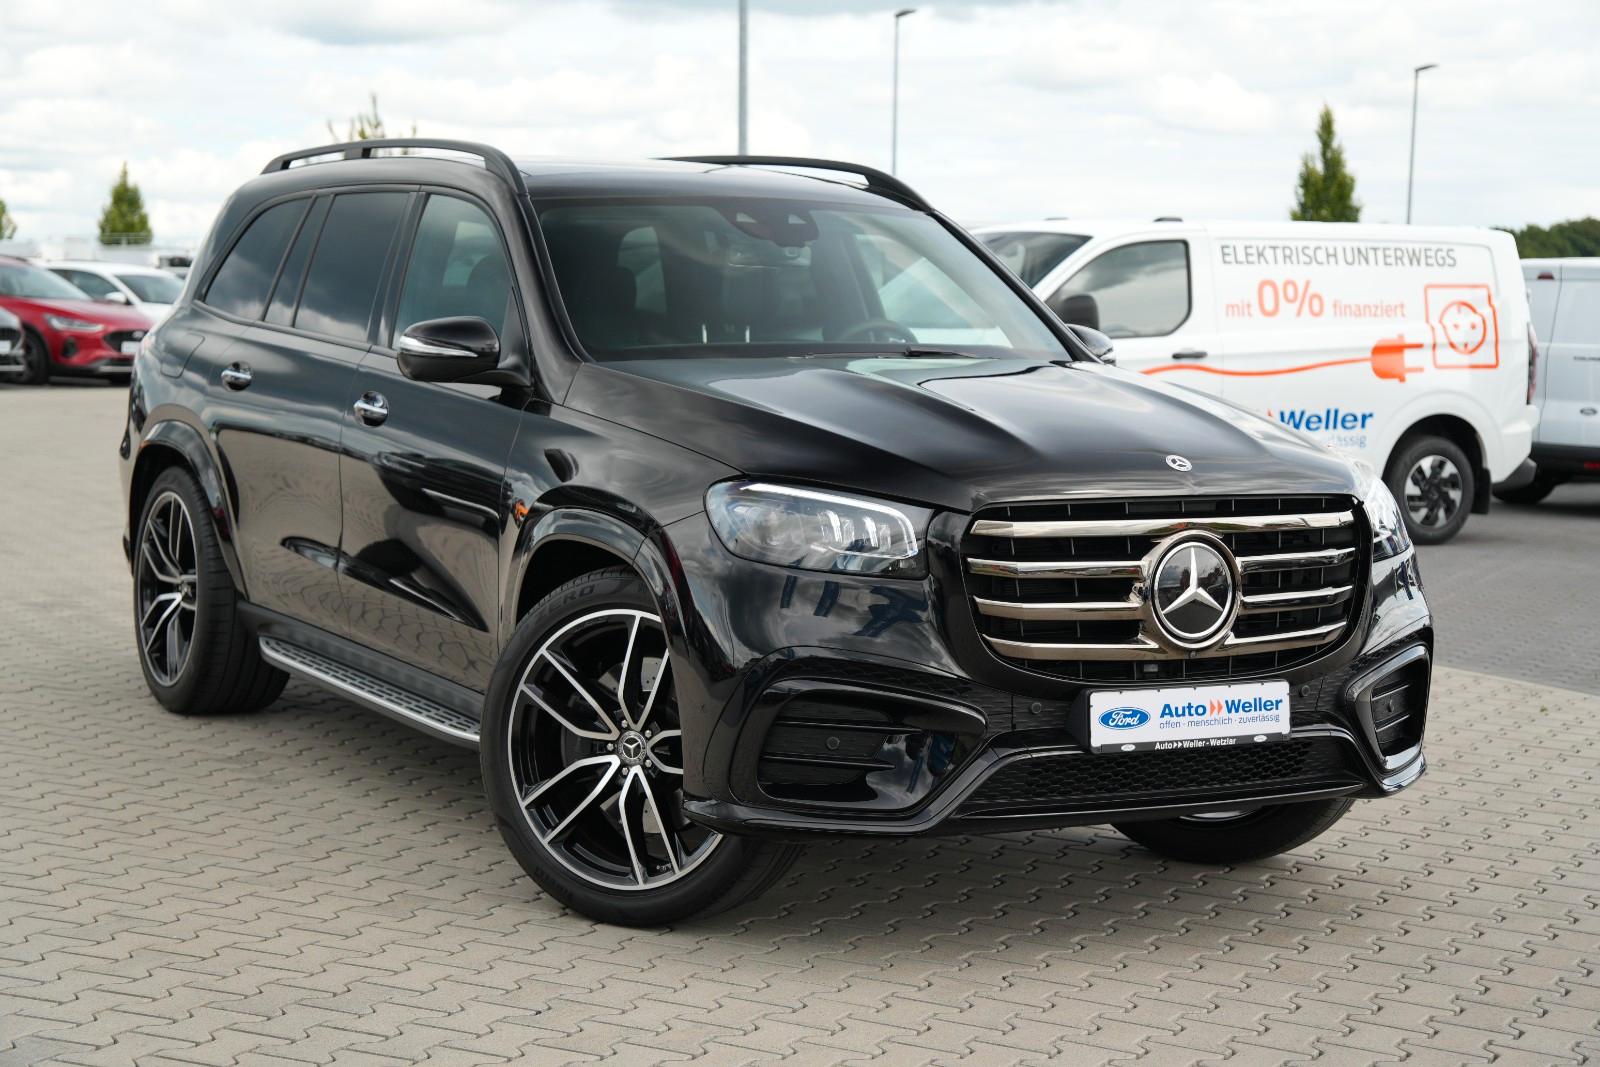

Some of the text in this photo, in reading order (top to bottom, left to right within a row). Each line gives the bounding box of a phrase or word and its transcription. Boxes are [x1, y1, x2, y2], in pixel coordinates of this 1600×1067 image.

[1220, 244, 1458, 268] ELEKTRISCH UNTERWEGS
[1225, 278, 1407, 318] mit 0% finanziert
[1279, 407, 1374, 432] Weller
[1108, 710, 1141, 726] Ford
[1159, 696, 1283, 719] Auto Weller
[1159, 719, 1181, 730] offen
[1187, 715, 1233, 728] menschlich
[1154, 741, 1173, 750] Auto
